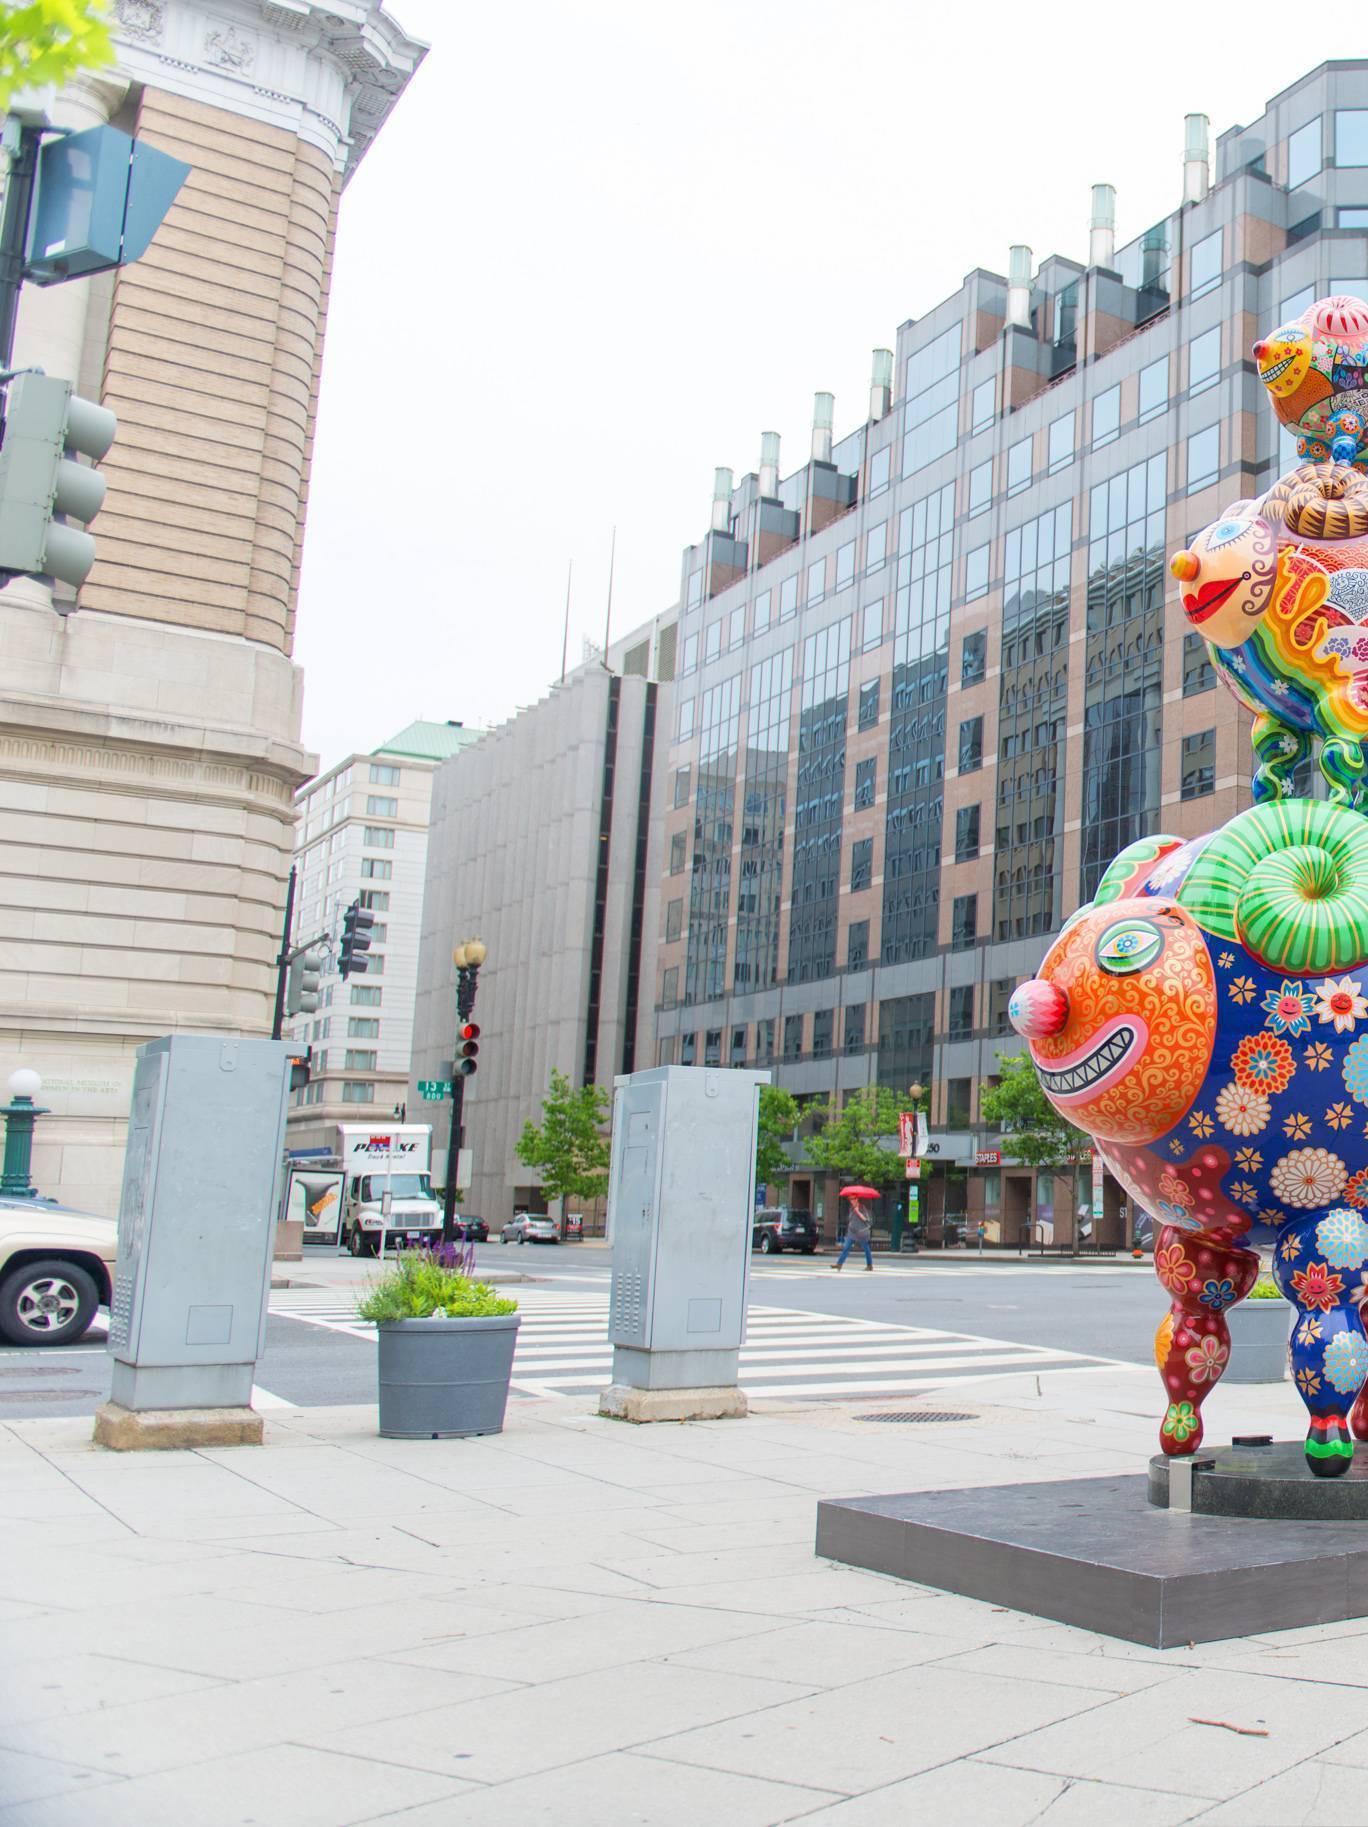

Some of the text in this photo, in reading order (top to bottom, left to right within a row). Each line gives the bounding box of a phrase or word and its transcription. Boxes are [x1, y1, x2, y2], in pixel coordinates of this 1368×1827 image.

[426, 1081, 437, 1091] 13
[353, 1143, 420, 1153] PENKE
[927, 1143, 940, 1153] 50
